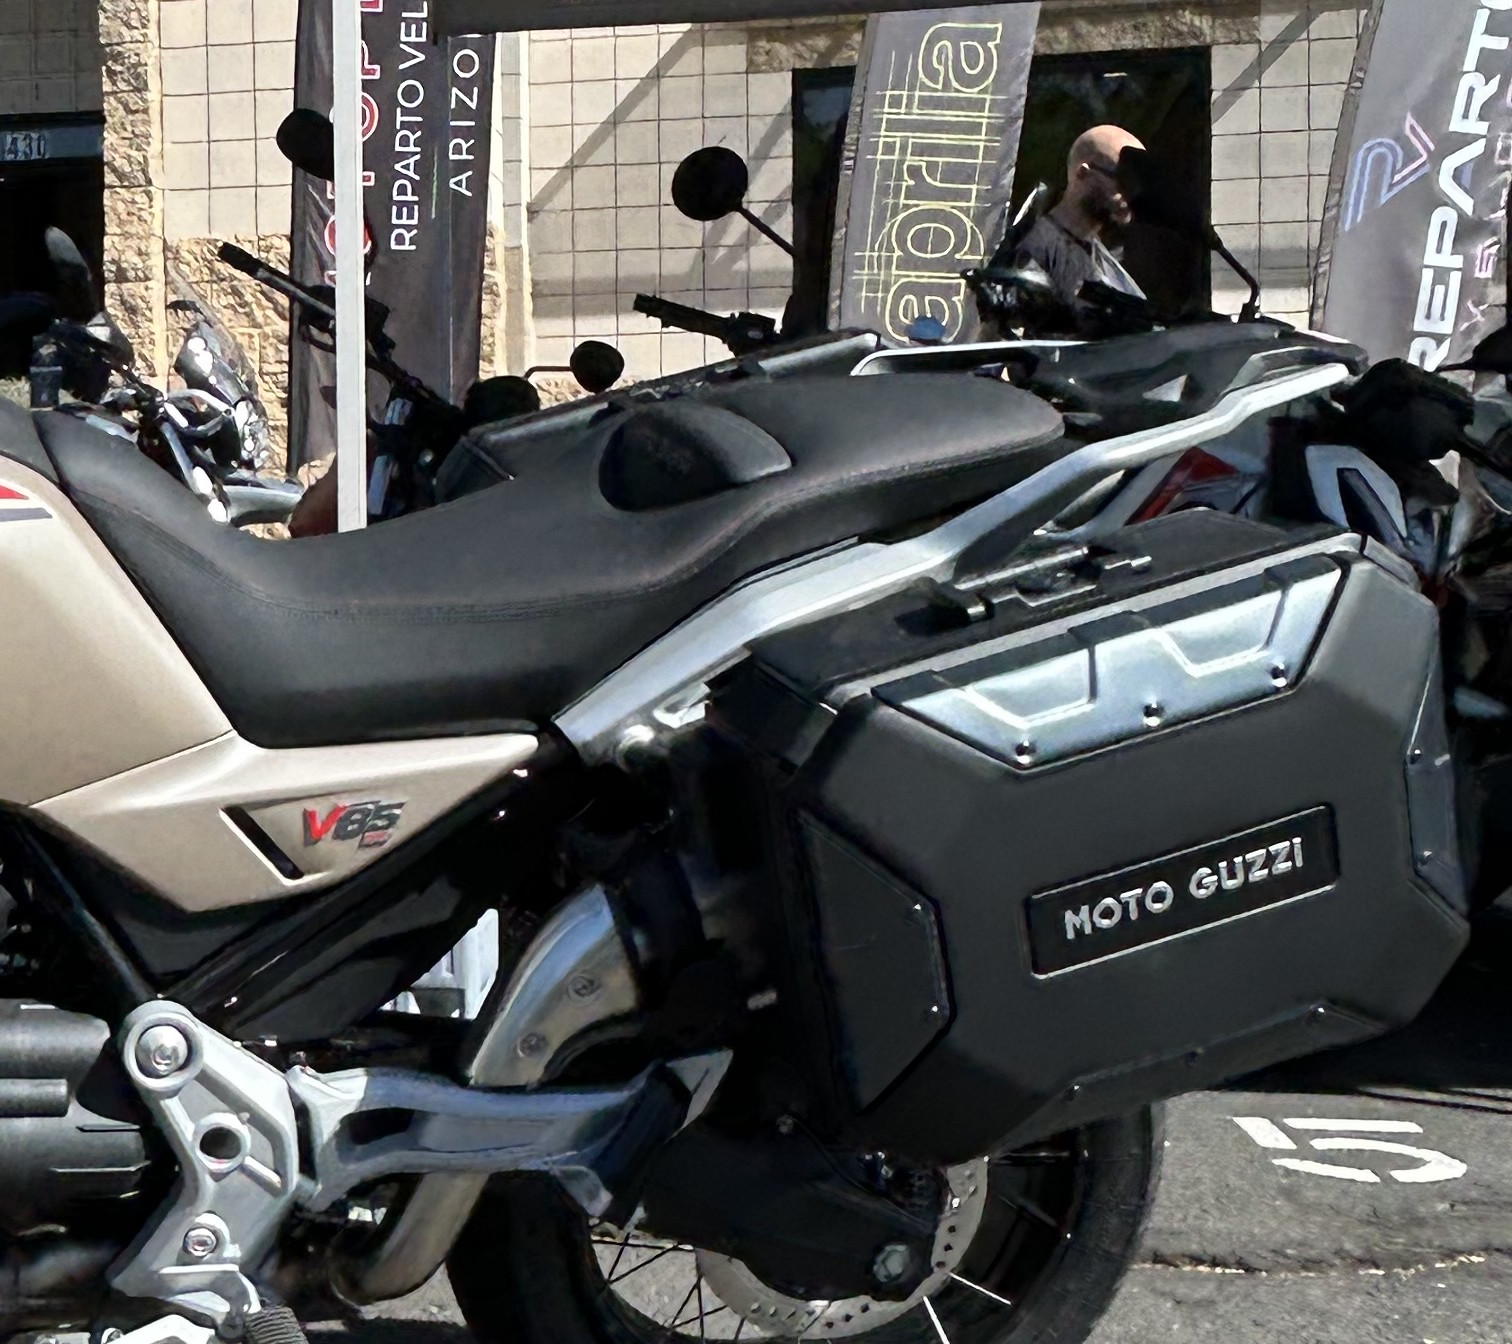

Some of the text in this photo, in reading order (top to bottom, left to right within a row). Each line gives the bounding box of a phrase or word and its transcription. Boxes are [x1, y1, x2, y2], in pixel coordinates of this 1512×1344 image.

[390, 79, 425, 251] REPARTO
[302, 800, 406, 847] V85
[1064, 837, 1304, 940] MOTO GUZZI
